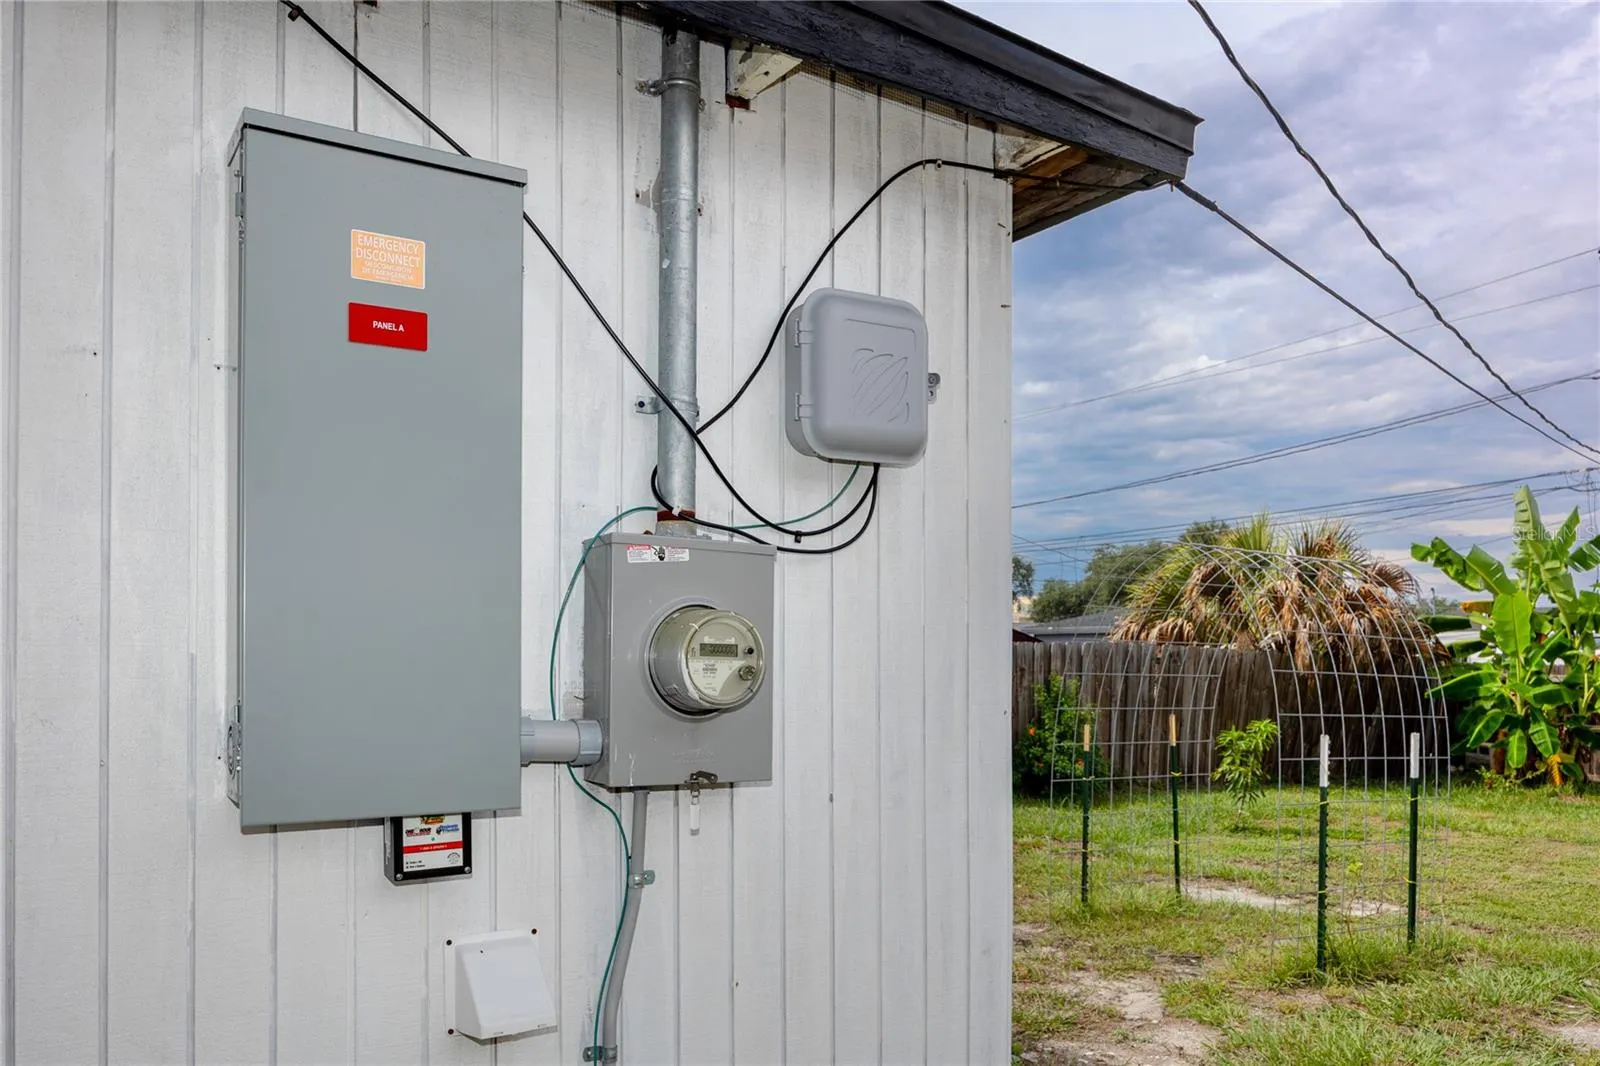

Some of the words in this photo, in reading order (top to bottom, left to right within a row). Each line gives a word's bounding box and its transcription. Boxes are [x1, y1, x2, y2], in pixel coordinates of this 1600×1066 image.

[357, 233, 420, 255] EMERGENCY
[355, 247, 421, 268] DISCONNECT
[372, 320, 397, 332] PANEL
[398, 323, 405, 332] A
